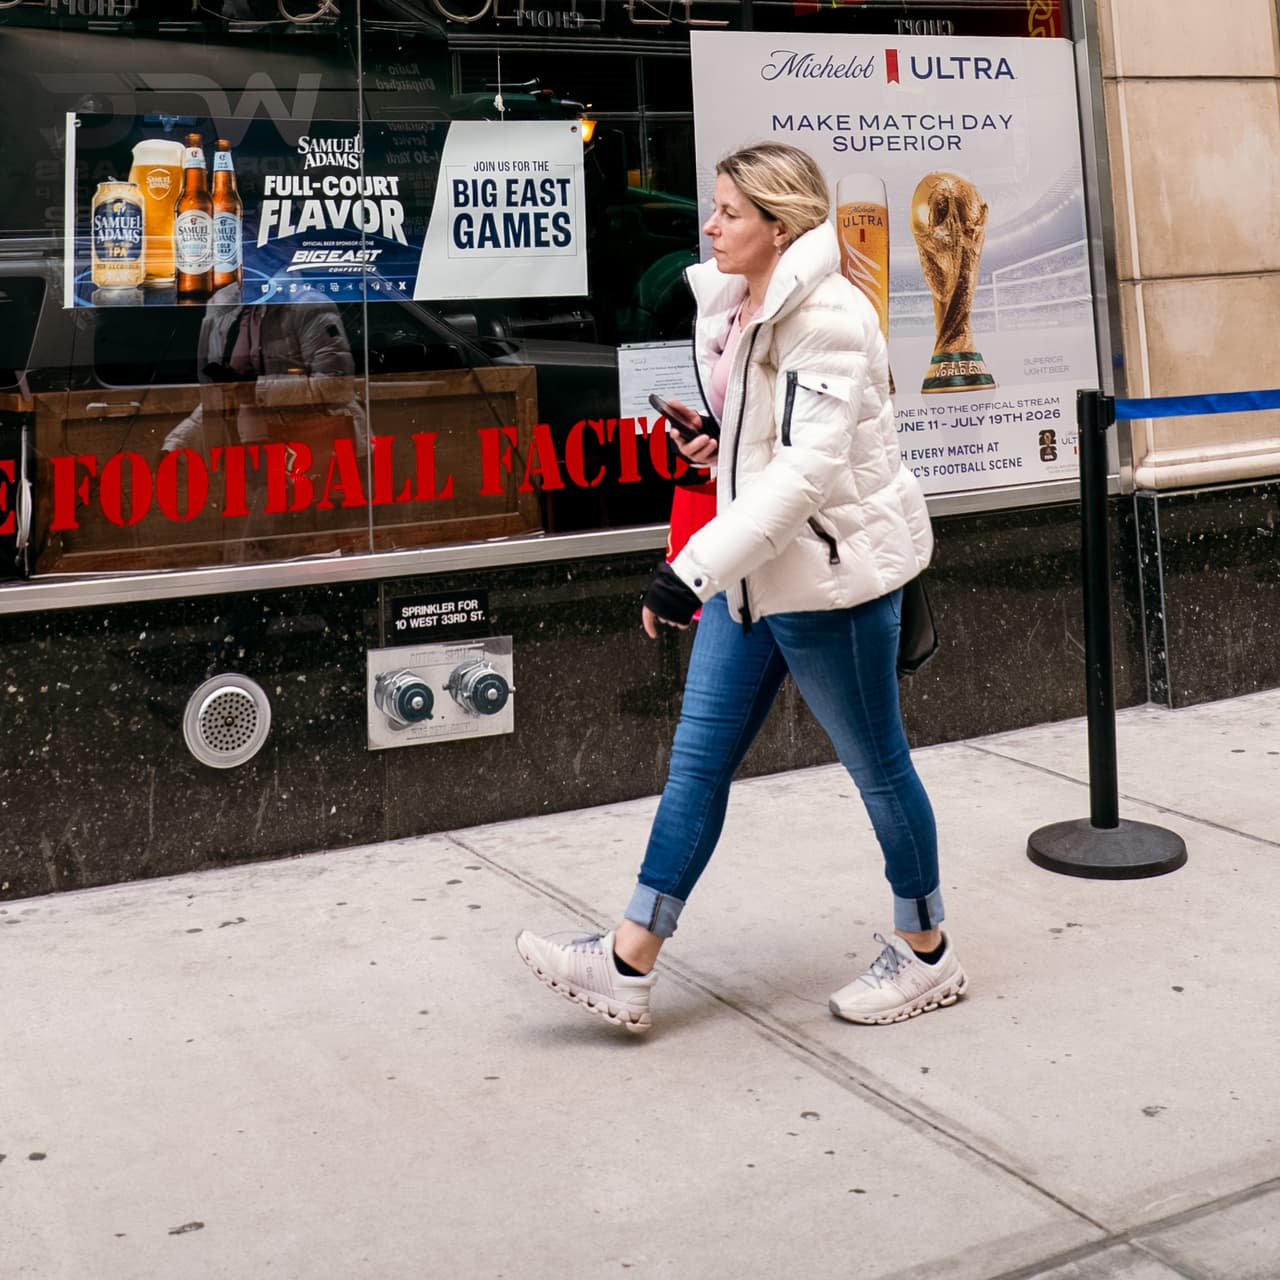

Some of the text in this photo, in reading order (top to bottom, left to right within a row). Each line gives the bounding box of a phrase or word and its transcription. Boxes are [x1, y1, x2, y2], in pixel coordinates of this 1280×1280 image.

[760, 49, 1015, 80] Michelob ULTRA
[772, 114, 1013, 131] MAKE MATCH DAY
[298, 130, 365, 155] SAMUEL
[832, 134, 962, 152] SUPERIOR
[304, 152, 361, 170] ADAMS
[474, 160, 549, 172] JOIN US FOR THE
[264, 175, 400, 197] FULL-COURT
[452, 179, 497, 208] BIG
[506, 178, 570, 208] EAST
[94, 214, 142, 230] SAMUEL
[178, 226, 210, 236] SAMUEL
[257, 199, 408, 248] FLAVOR
[453, 212, 571, 250] GAMES
[842, 215, 883, 228] ULTRA
[97, 227, 141, 244] ADAMS
[180, 234, 208, 243] ADAMS
[108, 247, 128, 257] IPA
[895, 409, 916, 418] UNE
[918, 408, 928, 416] IN
[930, 407, 945, 415] TO
[947, 405, 969, 414] THE
[1017, 397, 1060, 408] STREAM
[897, 421, 925, 433] UNE
[927, 420, 938, 431] 11
[951, 416, 985, 428] JULY
[989, 412, 1023, 425] 19TH
[1026, 409, 1061, 422] 2026
[911, 447, 944, 460] EVERY
[948, 444, 984, 457] MATCH
[987, 442, 999, 453] AT
[49, 431, 454, 531] FOOTBALL
[477, 417, 711, 496] FACTO
[933, 457, 1023, 476] FOOTBALL SCENE
[402, 599, 478, 618] SPRINKLER FOR
[395, 610, 485, 630] 10 WEST 33RD ST.
